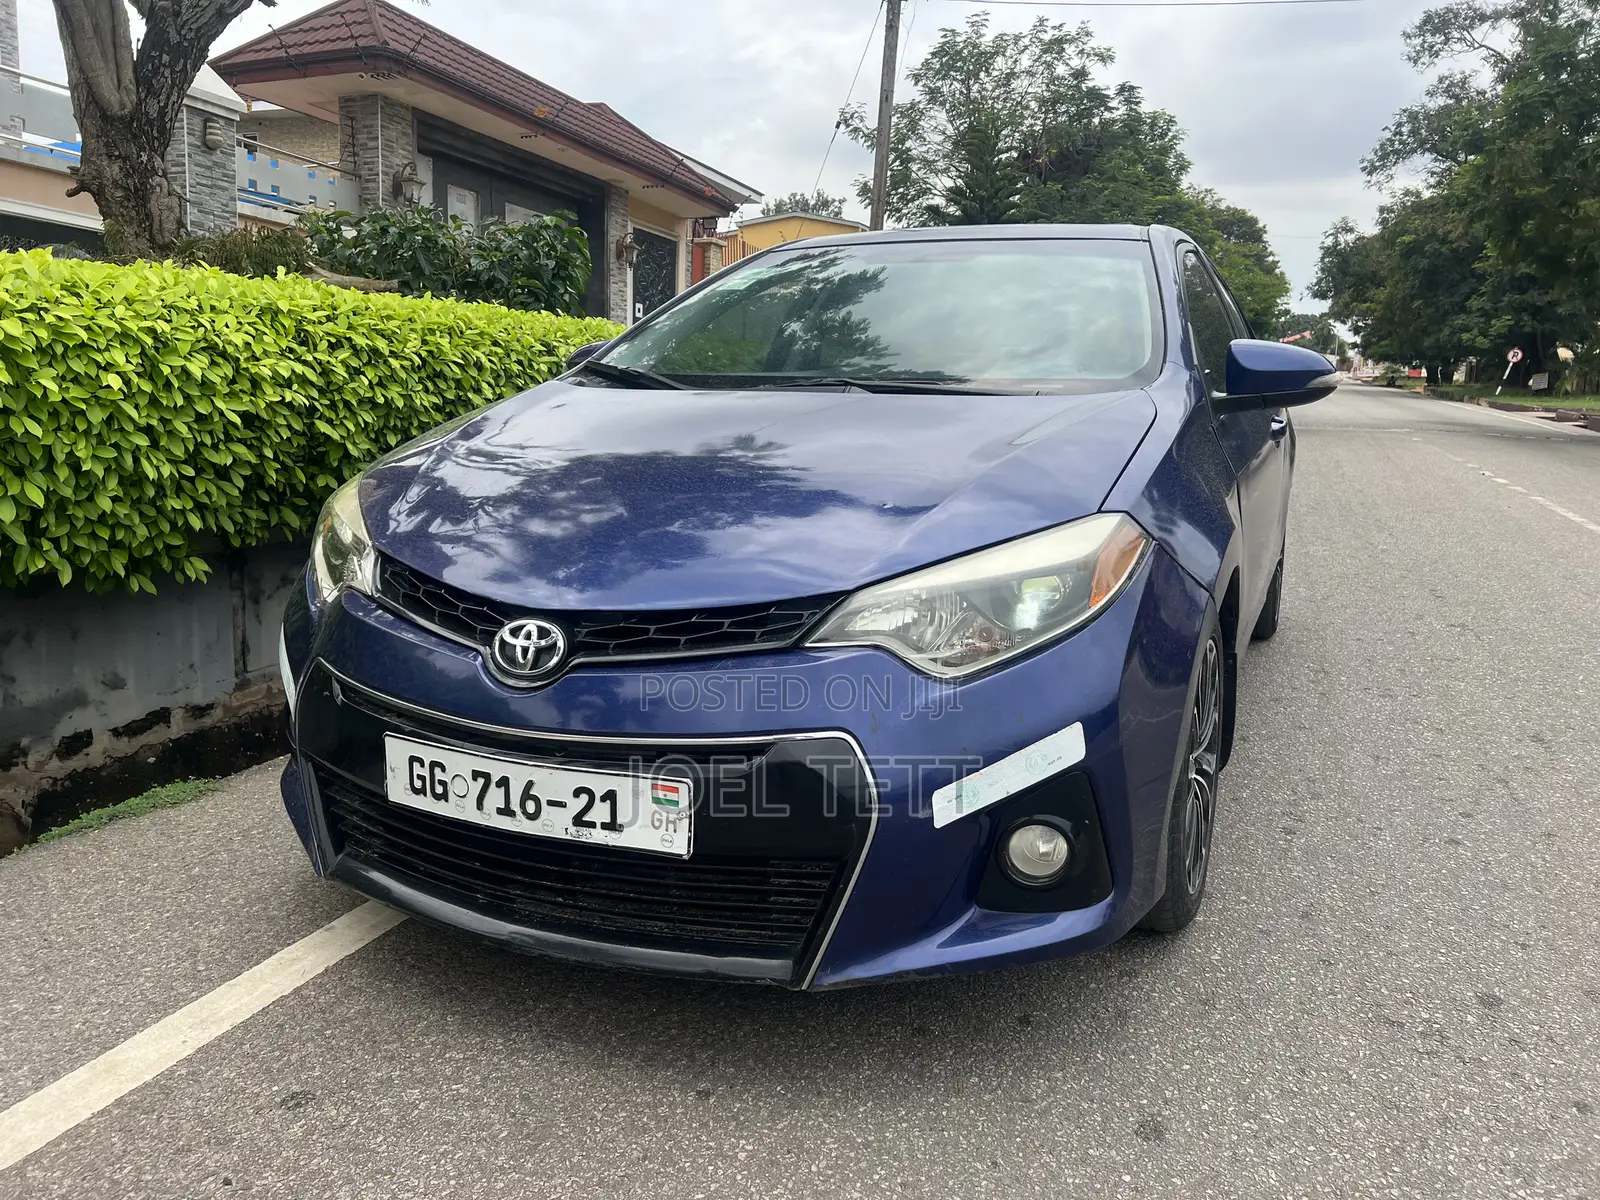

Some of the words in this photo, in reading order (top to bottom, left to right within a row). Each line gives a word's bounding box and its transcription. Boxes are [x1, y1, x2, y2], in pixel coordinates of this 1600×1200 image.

[408, 754, 449, 803] GG
[471, 769, 624, 833] 716-21
[651, 809, 678, 834] GH
